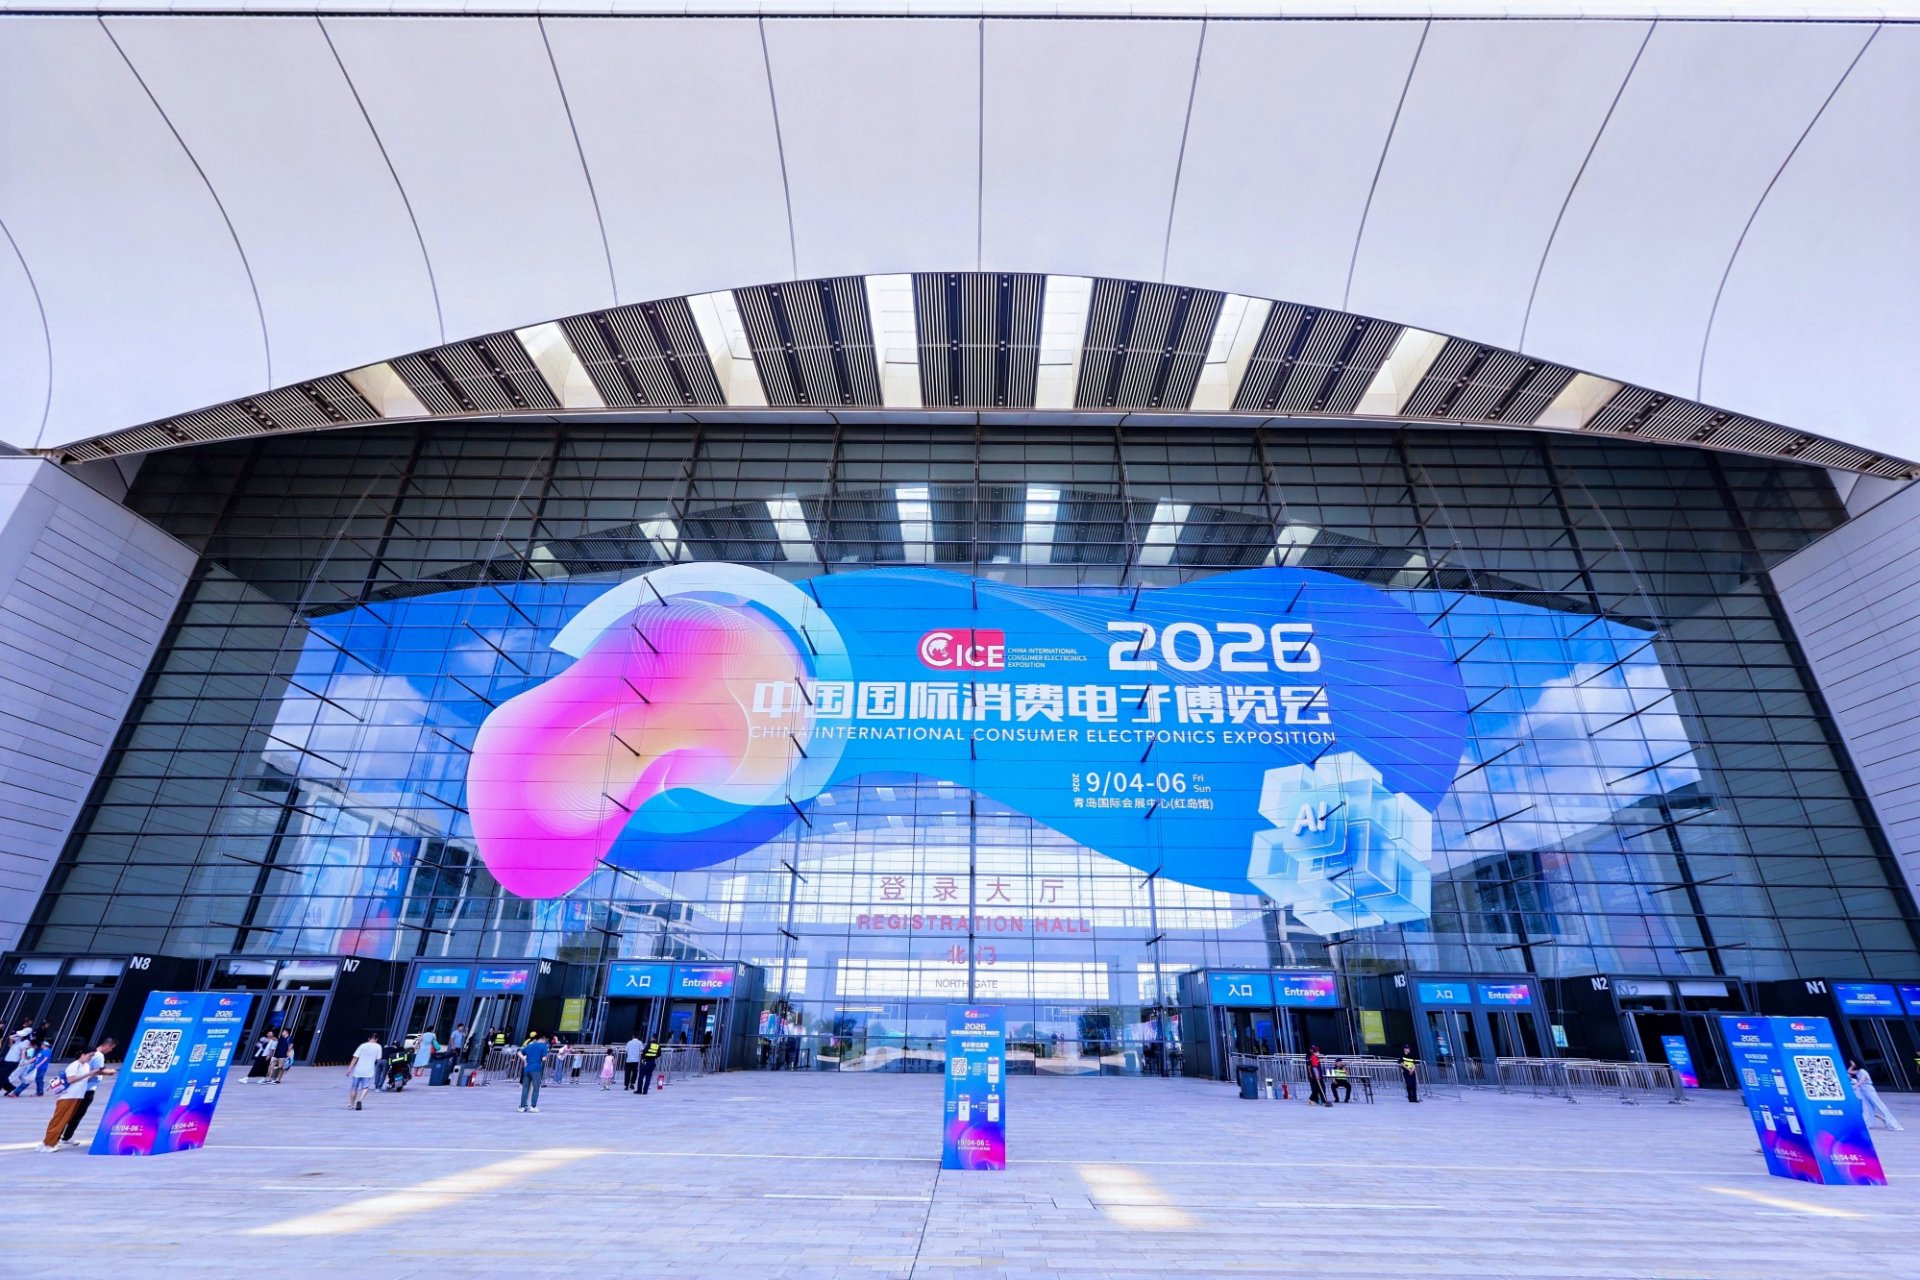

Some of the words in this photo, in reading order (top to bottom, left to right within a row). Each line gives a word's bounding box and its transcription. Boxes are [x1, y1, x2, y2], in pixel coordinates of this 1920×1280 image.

[1107, 621, 1321, 672] 2026
[752, 681, 1331, 725] 中国国际消费电子博览会
[750, 725, 808, 738] CHINA
[816, 726, 965, 741] INTERNATIONAL
[974, 728, 1078, 742] CONSUMER
[1087, 730, 1215, 744] ELECTRONICS
[1224, 731, 1337, 745] EXPOSITION
[1072, 773, 1080, 792] 2026
[1086, 772, 1186, 796] 9/04-06
[1193, 774, 1204, 782] Fri
[1194, 785, 1211, 793] Sun
[1074, 797, 1213, 810] 青岛国际会展中心(红岛馆)
[1291, 801, 1328, 836] AI
[880, 877, 1064, 903] 登录大厅
[857, 914, 1023, 932] REGISTRATION
[1036, 916, 1090, 933] HALL
[947, 944, 996, 965] 北门
[130, 956, 151, 970] N8
[343, 959, 360, 972] N7
[540, 961, 552, 975] N6
[482, 977, 510, 985] Emergency
[626, 975, 651, 988] 入口
[682, 978, 723, 988] Entrance
[935, 979, 968, 988] NORTH
[975, 979, 998, 989] GATE
[1394, 975, 1406, 988] N3
[1591, 977, 1609, 990] N2
[1806, 981, 1827, 994] N1
[1229, 984, 1253, 997] 入口
[1284, 987, 1325, 997] Entrance
[1436, 990, 1453, 999] 入口
[1488, 991, 1523, 1000] Entrance
